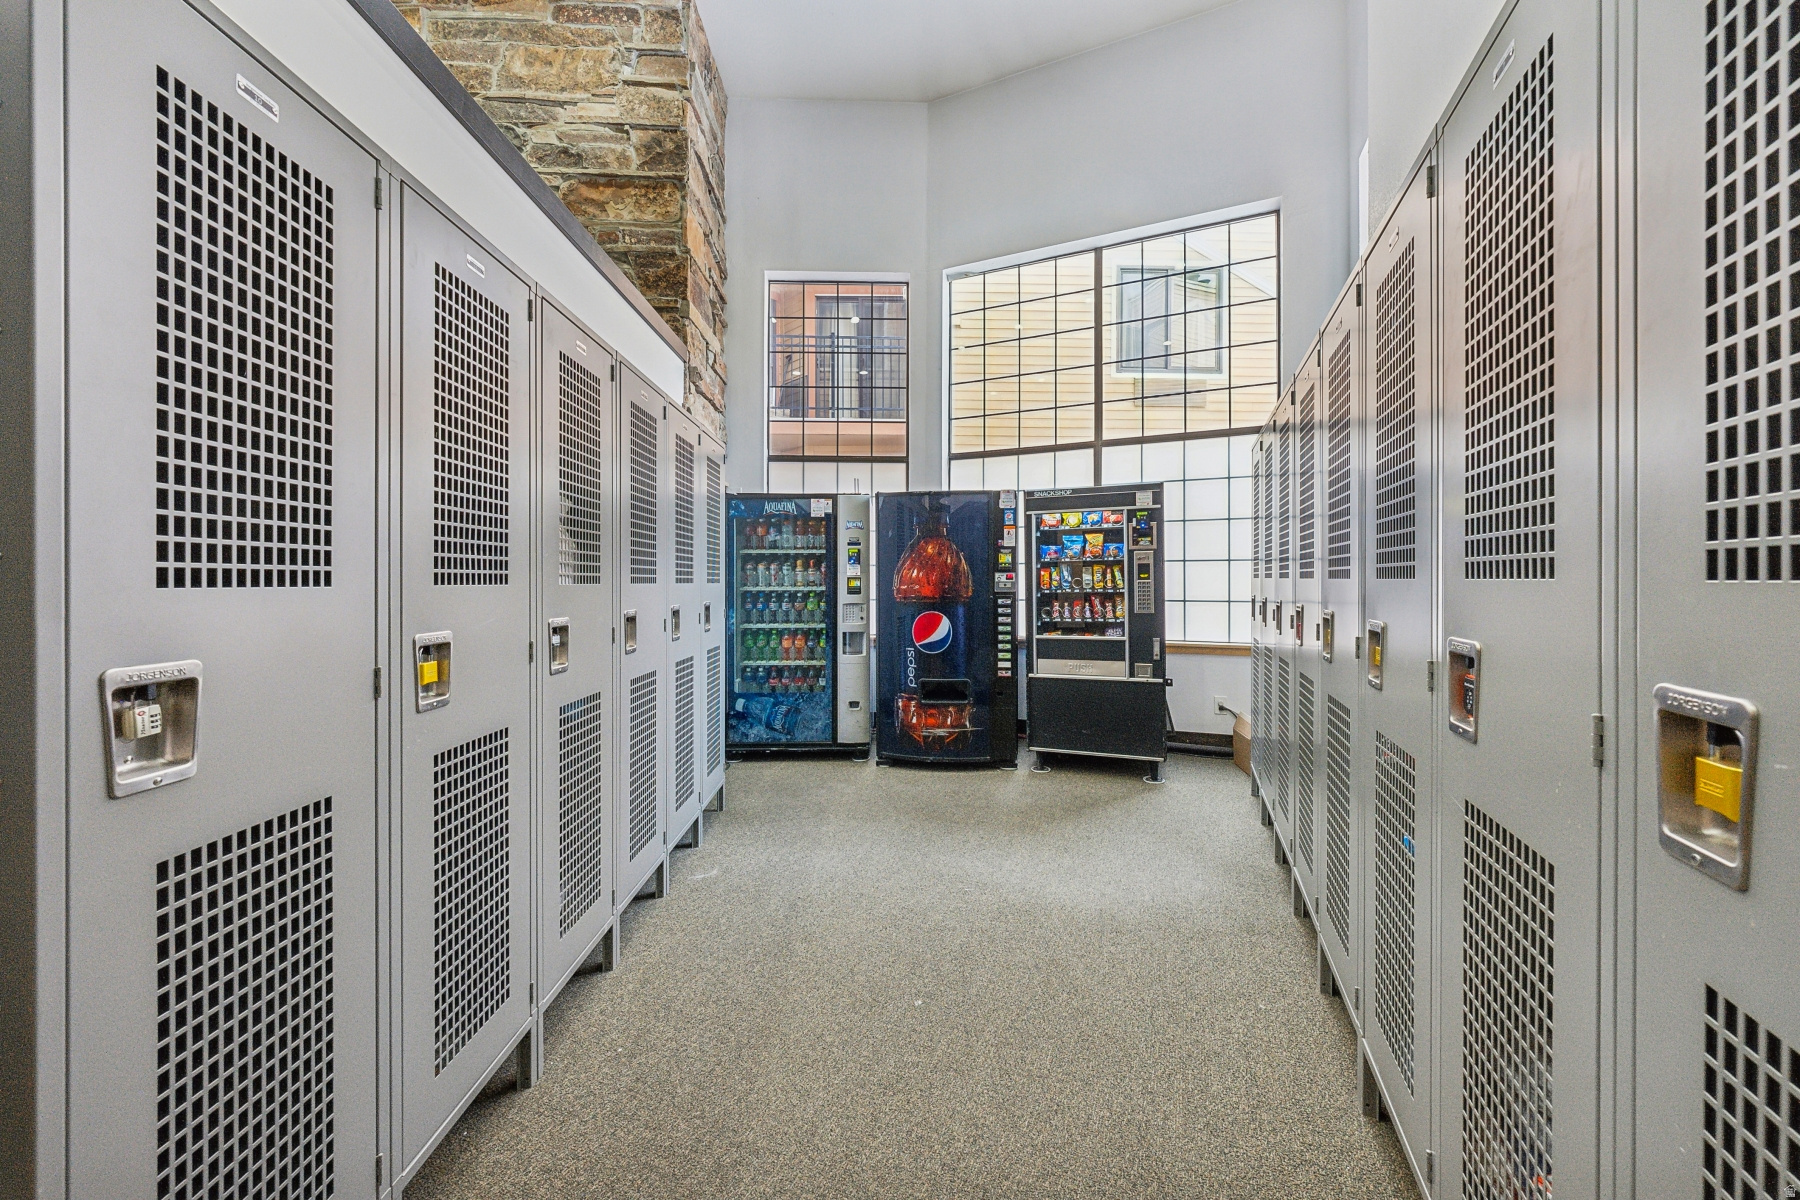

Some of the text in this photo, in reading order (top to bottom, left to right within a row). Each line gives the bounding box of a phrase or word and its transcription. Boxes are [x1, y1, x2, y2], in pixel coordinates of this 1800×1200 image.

[1033, 489, 1073, 498] SNACKSHOP
[763, 500, 797, 515] AQUAFINA
[125, 666, 187, 682] JORGENSON
[906, 647, 918, 688] pepsi
[1067, 662, 1094, 674] PUSH
